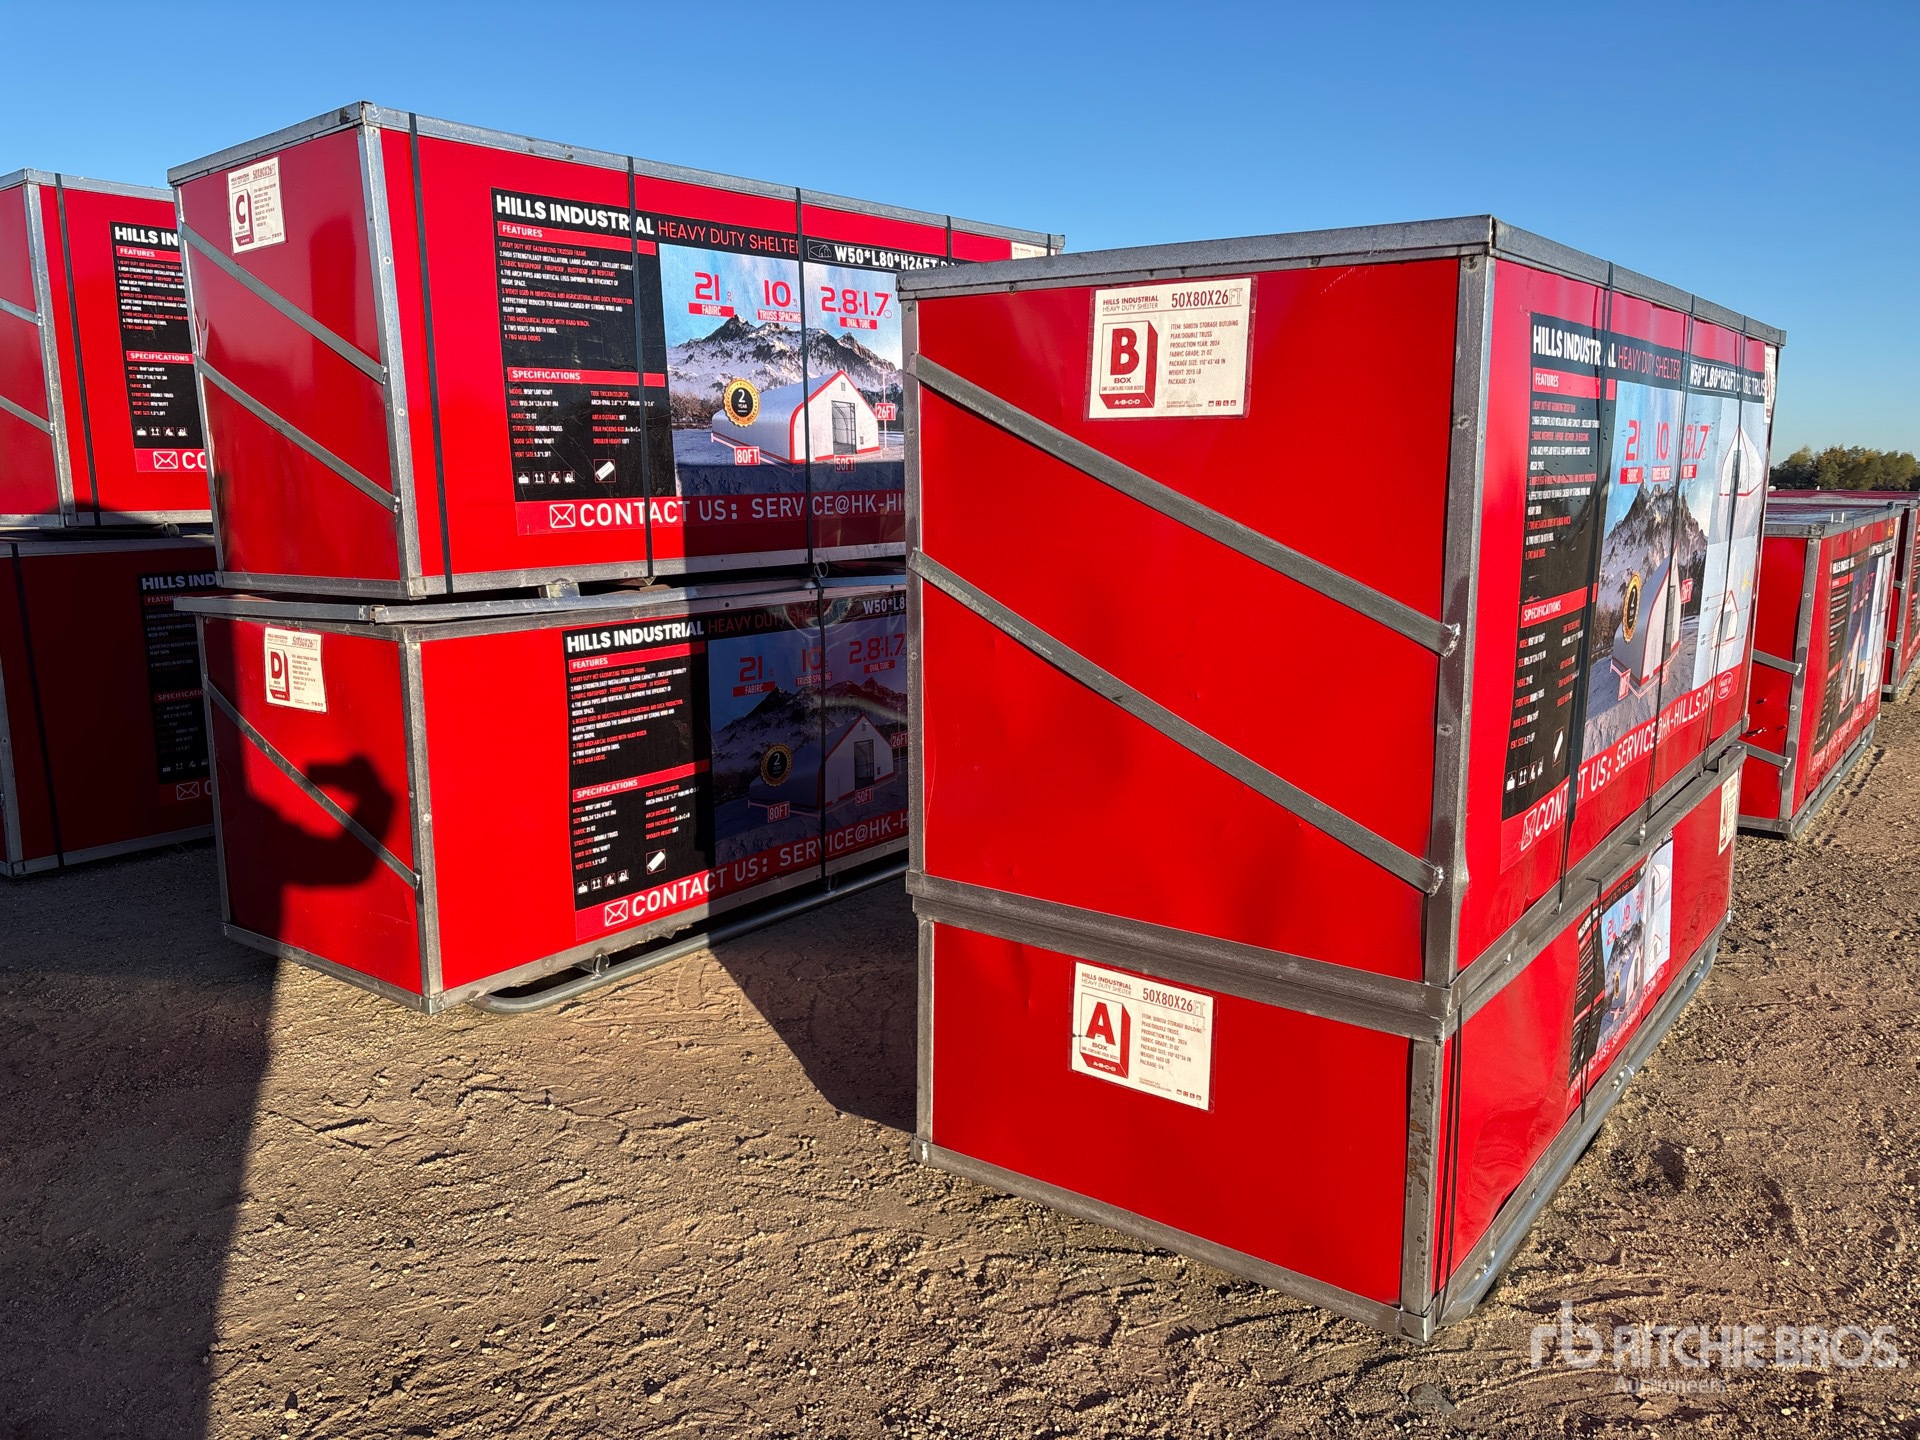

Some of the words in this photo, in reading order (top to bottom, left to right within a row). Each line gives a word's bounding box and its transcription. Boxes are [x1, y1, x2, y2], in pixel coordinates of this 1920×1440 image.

[236, 195, 246, 224] C
[496, 194, 546, 220] HILLS
[550, 202, 654, 234] INDUSTRAL
[658, 220, 708, 242] HEAVY
[710, 228, 746, 248] DUTY
[114, 226, 158, 244] HILLS
[502, 226, 542, 238] FEATURES
[120, 248, 154, 258] FEATURES
[694, 272, 720, 300] 21
[764, 280, 791, 308] 10
[1121, 295, 1158, 304] INDUSTRIAL
[1171, 287, 1242, 308] 50X80X26FT
[702, 305, 721, 316] FABIRC
[760, 310, 777, 322] TRUSS
[130, 352, 190, 362] SPECIFICATIONS
[1110, 327, 1140, 374] B
[1533, 325, 1562, 358] HILLS
[1618, 345, 1641, 372] HEAVY
[512, 370, 580, 380] SPECIFICATIONS
[1536, 372, 1558, 388] FEATURES
[738, 390, 745, 402] 2
[878, 406, 894, 419] 26FT
[1626, 420, 1641, 460] 21
[1656, 422, 1669, 460] 10
[736, 449, 758, 464] 80FT
[836, 458, 854, 471] 50FT
[580, 500, 690, 526] CONTACT
[700, 500, 738, 520] US:
[142, 576, 186, 590] HILLS
[1524, 600, 1562, 622] SPECIFICATIONS
[566, 631, 612, 652] HILLS
[614, 621, 704, 646] INDUSTRIAL
[708, 616, 752, 634] HEAVY
[754, 612, 785, 627] DUTY
[270, 651, 282, 679] D
[573, 658, 608, 670] FEATURES
[802, 647, 822, 672] 10
[740, 656, 762, 682] 21
[744, 684, 764, 694] FABIRC
[774, 754, 780, 766] 2
[1590, 754, 1614, 792] US:
[576, 779, 638, 798] SPECIFICATIONS
[856, 789, 872, 804] 50FT
[769, 804, 789, 820] 80FT
[632, 868, 728, 916] CONTACT
[734, 857, 768, 882] US:
[1081, 971, 1096, 980] HILLS
[1098, 976, 1131, 990] INDUSTRIAL
[1081, 978, 1097, 986] HEAVY
[1085, 998, 1117, 1045] A
[1092, 1041, 1107, 1051] BOX
